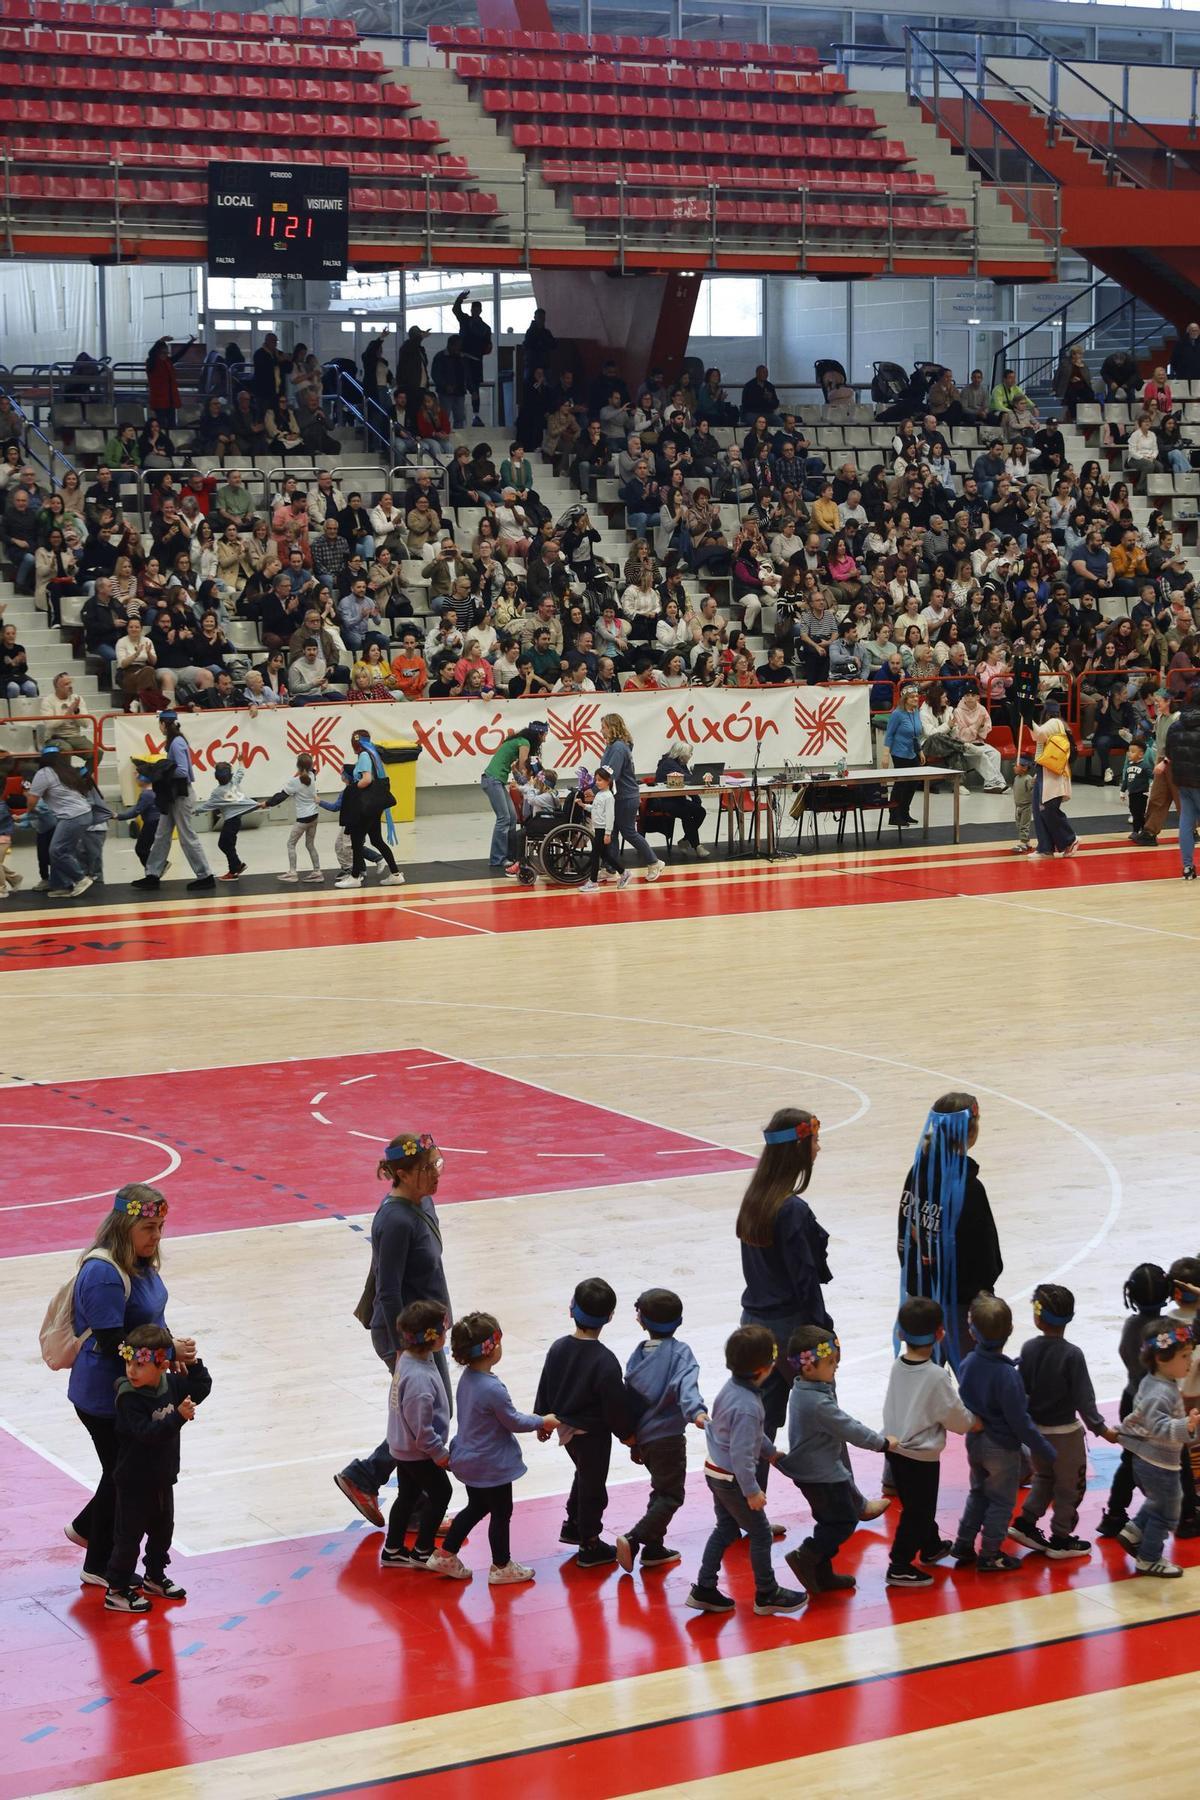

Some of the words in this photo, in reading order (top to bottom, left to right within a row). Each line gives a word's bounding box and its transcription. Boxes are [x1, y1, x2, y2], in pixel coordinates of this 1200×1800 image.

[270, 171, 292, 179] PERIODO
[217, 195, 254, 207] LOCAL
[307, 198, 343, 210] VISITANTE
[666, 701, 779, 744] Xixón
[412, 713, 516, 764] Xixó
